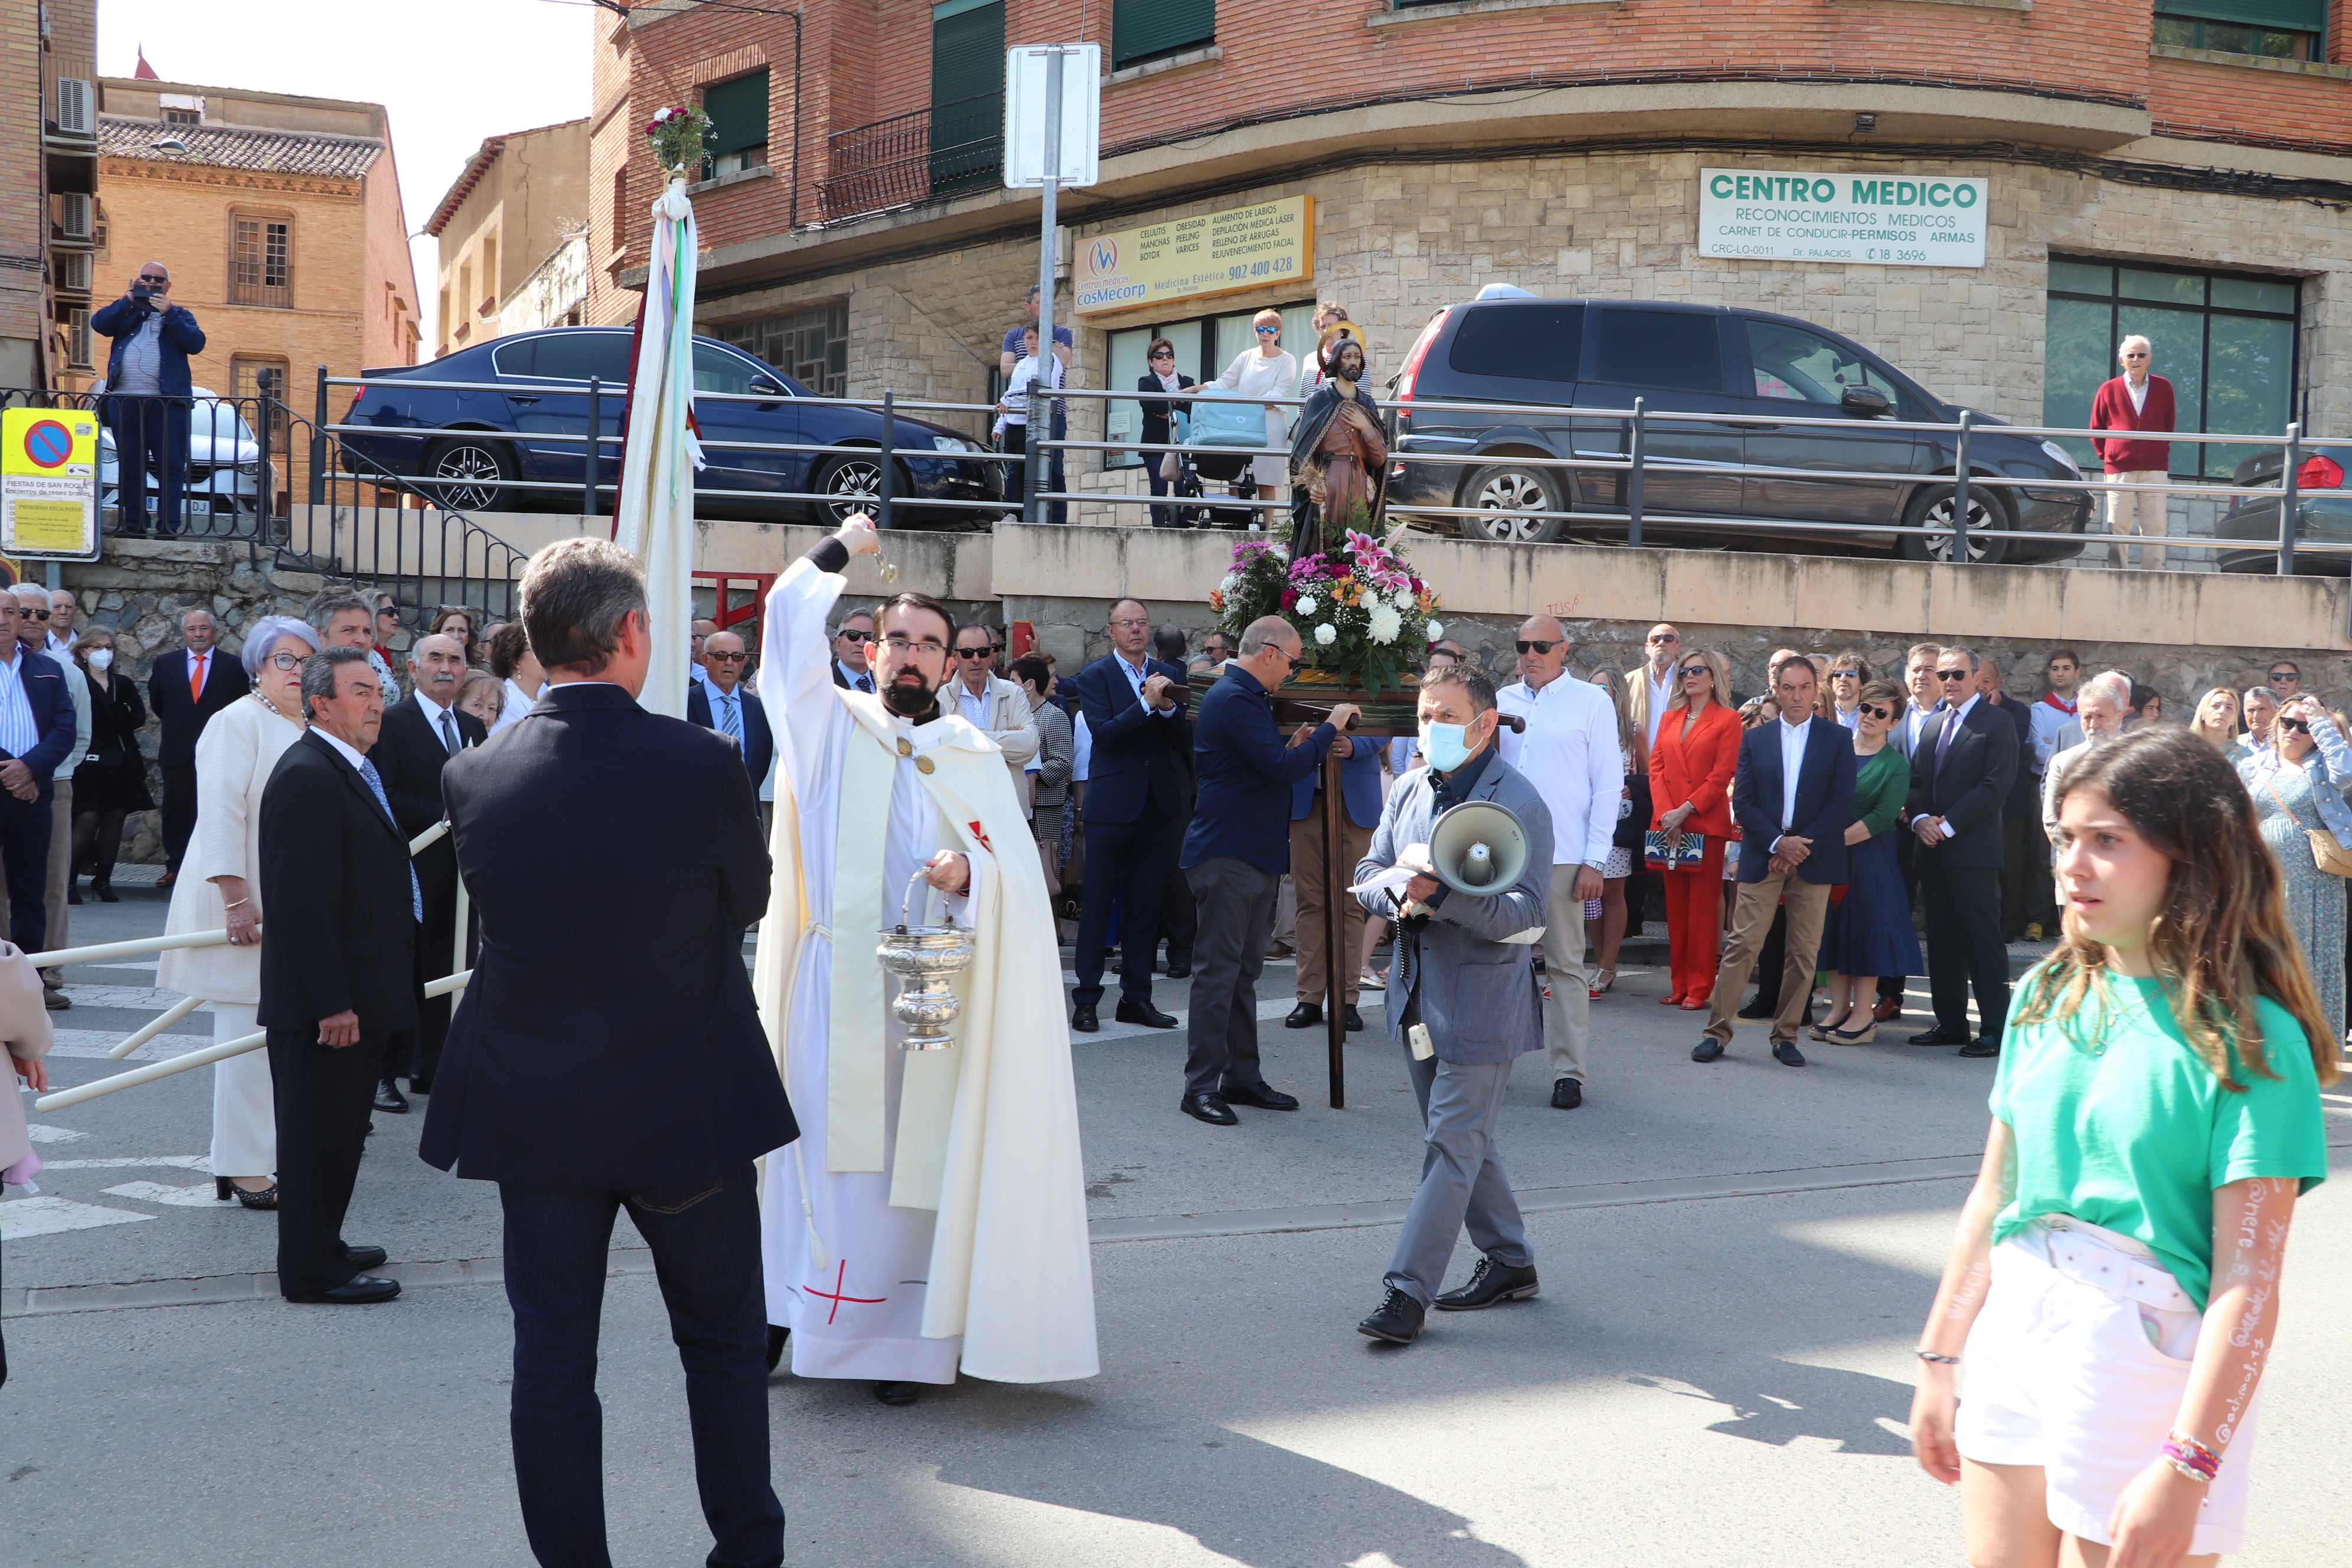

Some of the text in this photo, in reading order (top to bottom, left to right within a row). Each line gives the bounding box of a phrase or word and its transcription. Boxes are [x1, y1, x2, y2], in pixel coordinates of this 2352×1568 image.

[1710, 174, 1977, 208] CENTRO MEDICO
[1212, 211, 1243, 225] AUMENTO
[1255, 205, 1277, 216] LABIOS
[1736, 208, 1955, 228] RECONOCIMIENTOS MEDICOS
[1141, 227, 1166, 239] CELULITIS
[1176, 219, 1206, 231] OBESIDAD
[1212, 214, 1294, 236] DEPILACIÓN MÉDICA LÁSER
[1719, 225, 1975, 243] CARNET DE CONDUCIR-PERMISOS ARMAS
[1140, 237, 1170, 250] MANCHAS
[1176, 231, 1200, 243] PEELING
[1212, 228, 1279, 248] RELLENO DE ARRUGAS
[1140, 250, 1160, 261] BOTOX
[1175, 243, 1200, 254] VARICES
[1212, 237, 1294, 259] REJUVENECIMIENTO FACIAL
[1711, 243, 1926, 261] CRC-LO-0011 Dr. PALACIOS 18 3696
[1229, 256, 1292, 281] 902 400 428
[1077, 275, 1129, 292] Centros médicos
[1155, 271, 1224, 290] Medicina Estética
[1077, 283, 1146, 306] cosMecorp
